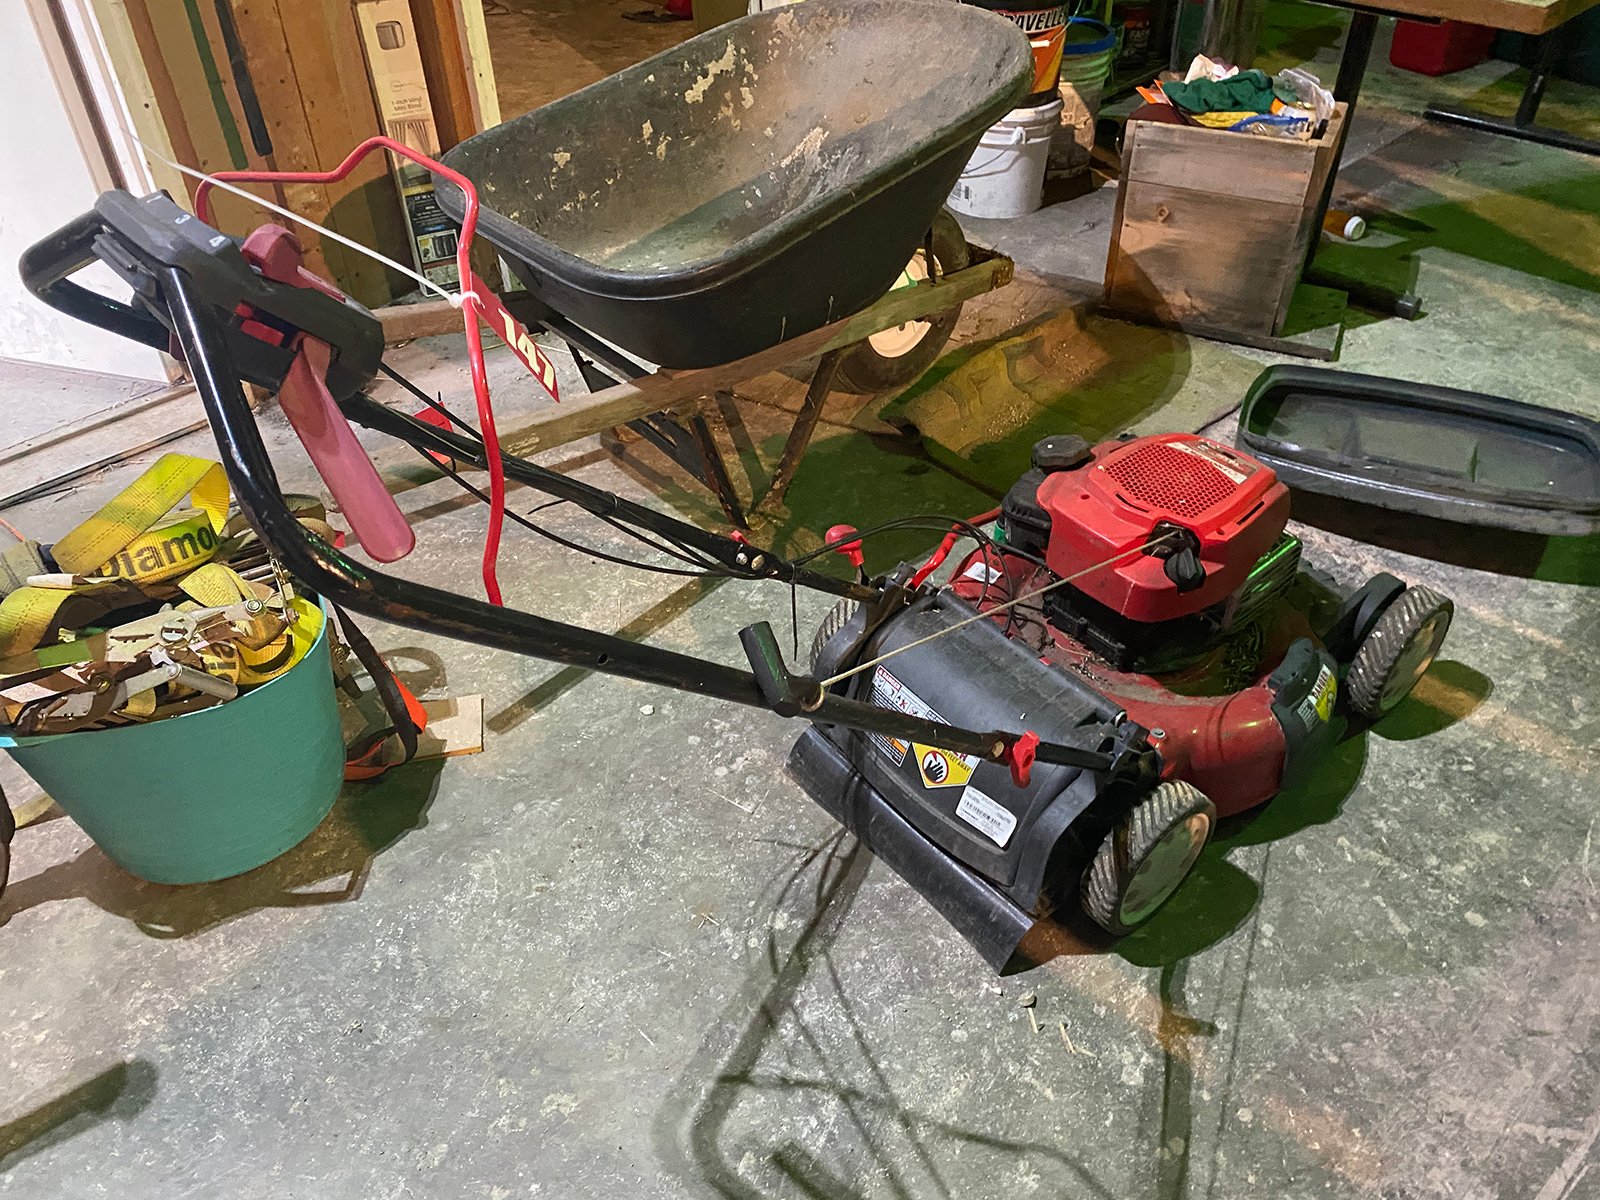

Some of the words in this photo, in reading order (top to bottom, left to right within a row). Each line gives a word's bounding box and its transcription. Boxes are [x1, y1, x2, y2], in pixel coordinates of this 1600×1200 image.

[175, 213, 191, 225] 3
[209, 235, 226, 247] 4
[498, 307, 555, 392] 147
[94, 522, 219, 578] Diamo
[1311, 671, 1329, 698] DANGER
